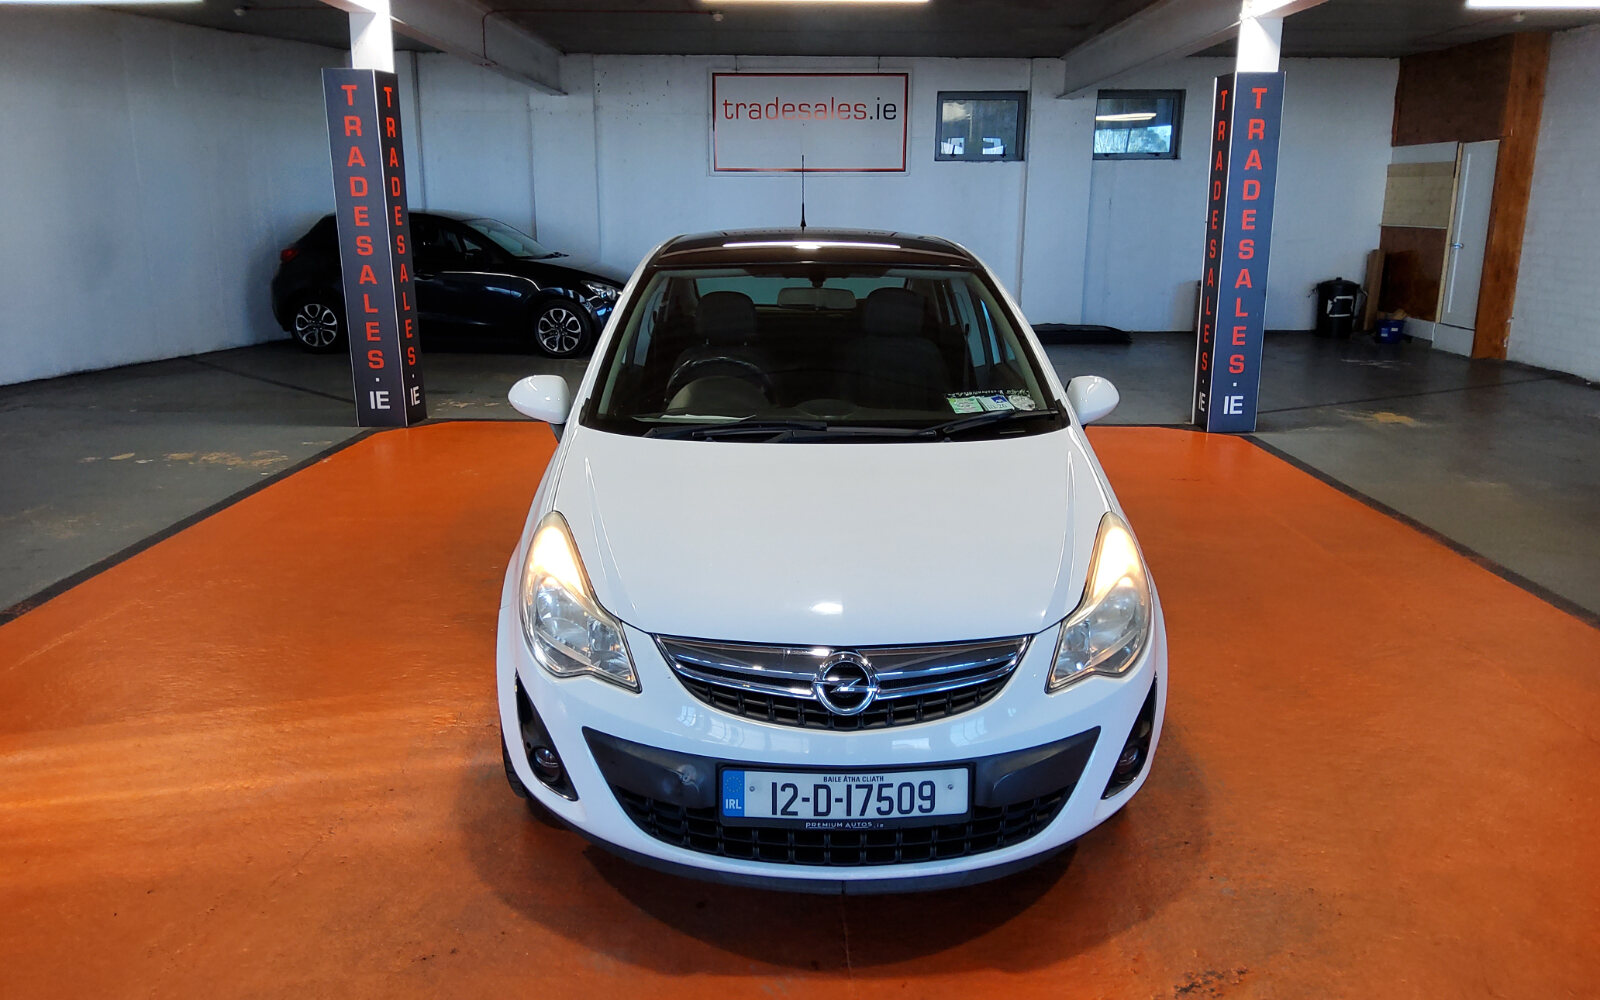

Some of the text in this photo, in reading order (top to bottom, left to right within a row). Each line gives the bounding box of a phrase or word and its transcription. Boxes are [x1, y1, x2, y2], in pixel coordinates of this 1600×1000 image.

[723, 97, 898, 120] tradesales.ie
[340, 84, 391, 411] TRADESALES.IE
[1223, 87, 1268, 416] TRADESALES.IE
[823, 775, 842, 783] BAILE
[862, 774, 884, 783] CLIATH
[725, 798, 742, 810] IRL
[771, 780, 936, 816] 12-D-17509
[805, 821, 843, 829] PREMIUM
